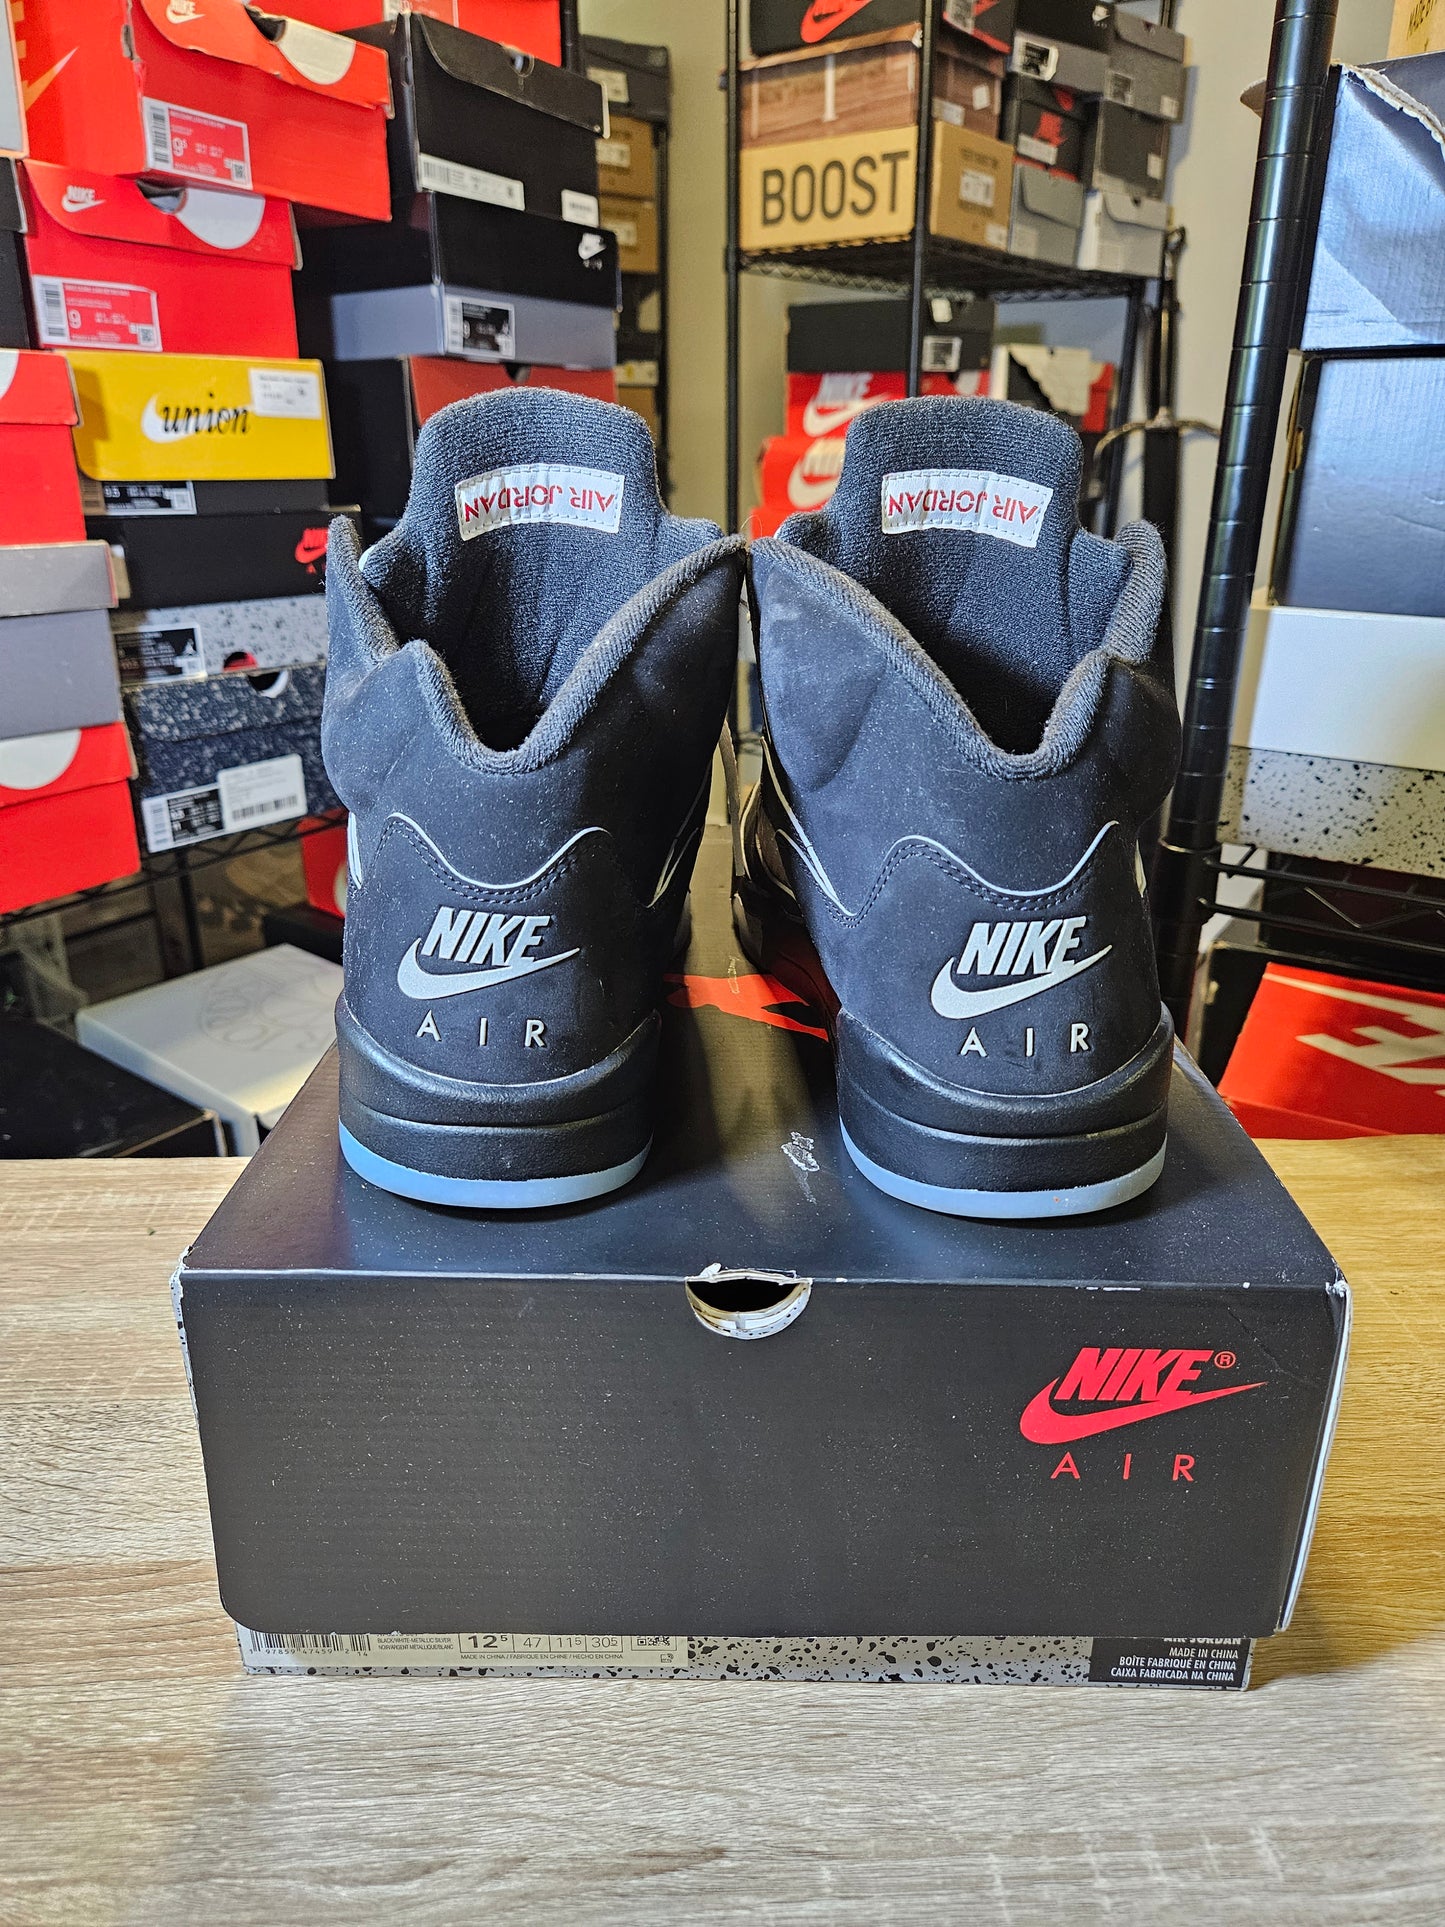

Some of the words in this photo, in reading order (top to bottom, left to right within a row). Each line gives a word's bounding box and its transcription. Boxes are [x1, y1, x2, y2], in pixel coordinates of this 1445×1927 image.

[762, 150, 909, 226] BOOST
[163, 392, 249, 434] union
[465, 484, 563, 522] JORDAN
[569, 486, 615, 512] AIR
[888, 489, 987, 517] JORDAN
[992, 495, 1038, 524] AIR
[420, 906, 551, 966] NIKE
[956, 915, 1087, 976] NIKE
[416, 1009, 547, 1047] AIR
[959, 1022, 1090, 1057] AIR
[1053, 1347, 1214, 1401] NIKE
[1050, 1451, 1195, 1482] AIR
[523, 1637, 541, 1648] 47
[1169, 1647, 1195, 1657] MADE
[1198, 1648, 1208, 1658] IN
[1210, 1649, 1239, 1659] CHINA
[1110, 1667, 1137, 1677] CAIXA
[1139, 1669, 1189, 1680] FABRICADA
[1191, 1671, 1204, 1680] NA
[1206, 1672, 1235, 1681] CHINA
[1119, 1655, 1146, 1667] BOÎTE
[1147, 1657, 1192, 1669] FABRIQUÉ
[1194, 1661, 1206, 1669] EN
[1208, 1661, 1237, 1670] CHINA
